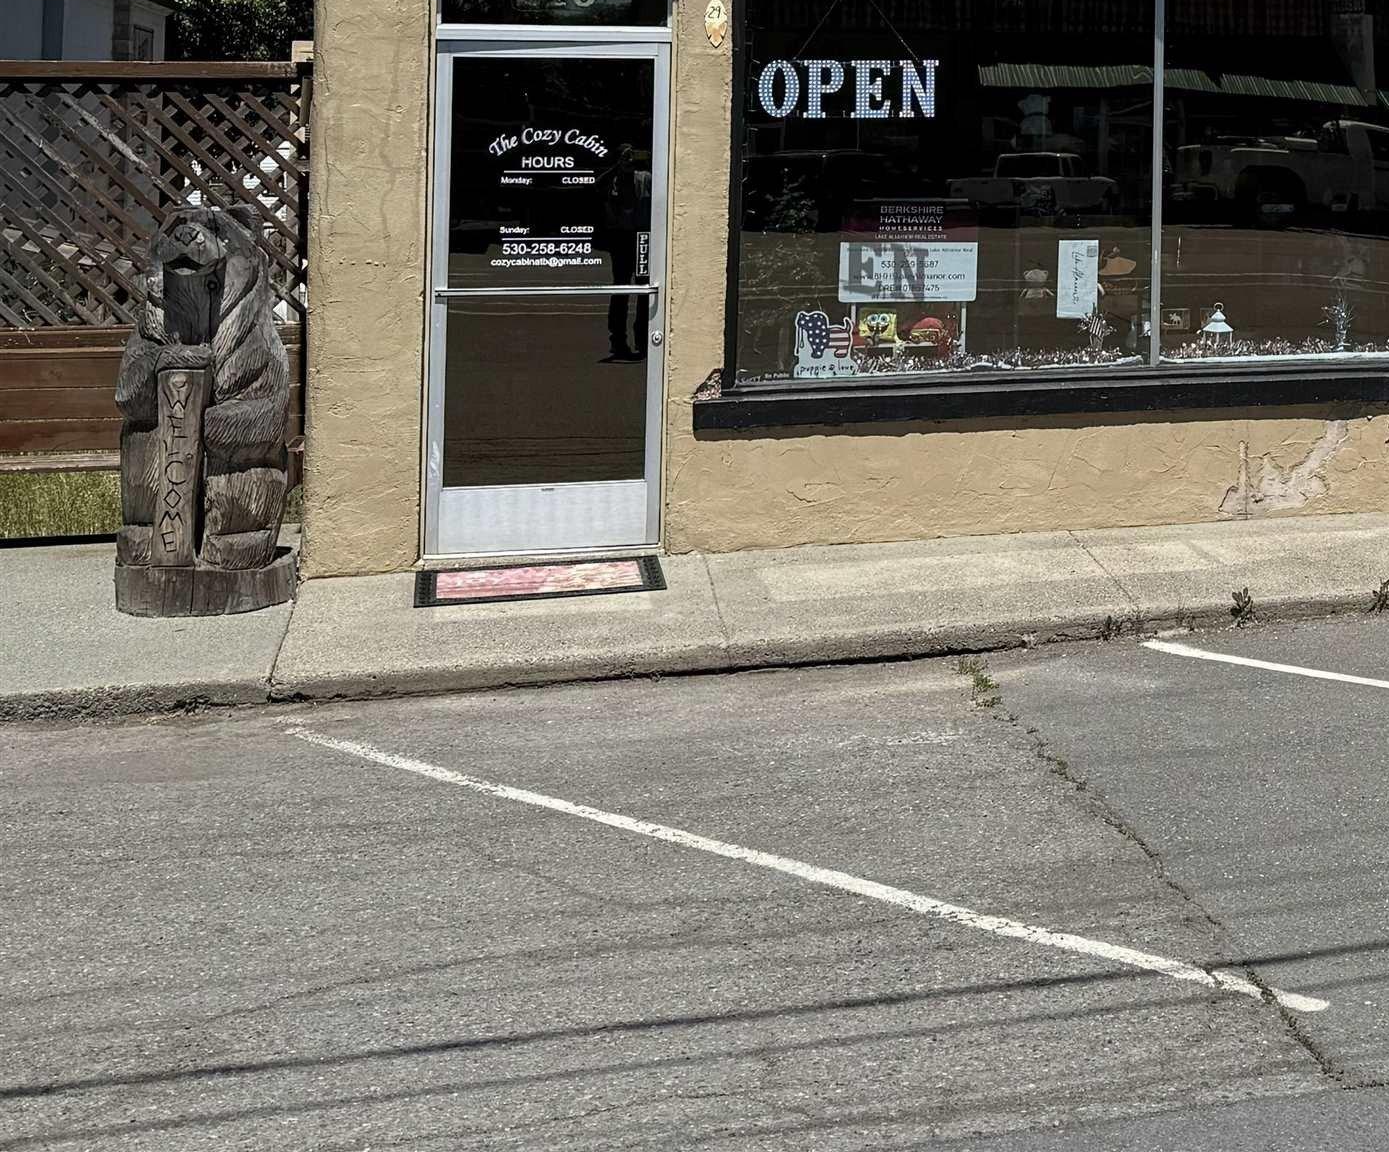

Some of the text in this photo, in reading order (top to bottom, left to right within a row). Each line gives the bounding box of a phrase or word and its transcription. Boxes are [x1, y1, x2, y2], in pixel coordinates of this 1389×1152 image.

[758, 59, 940, 119] OPEN
[488, 128, 609, 158] The Cozy Cabin
[521, 156, 575, 168] HOURS
[500, 176, 596, 185] Monday: CLOSED
[880, 205, 945, 214] BERKSHIRE
[879, 215, 943, 224] HATHAWAY
[499, 225, 595, 235] Sunday: CLOSED
[502, 242, 593, 255] 530-258-6248
[639, 234, 648, 275] PULL
[158, 388, 193, 554] WELCOME
